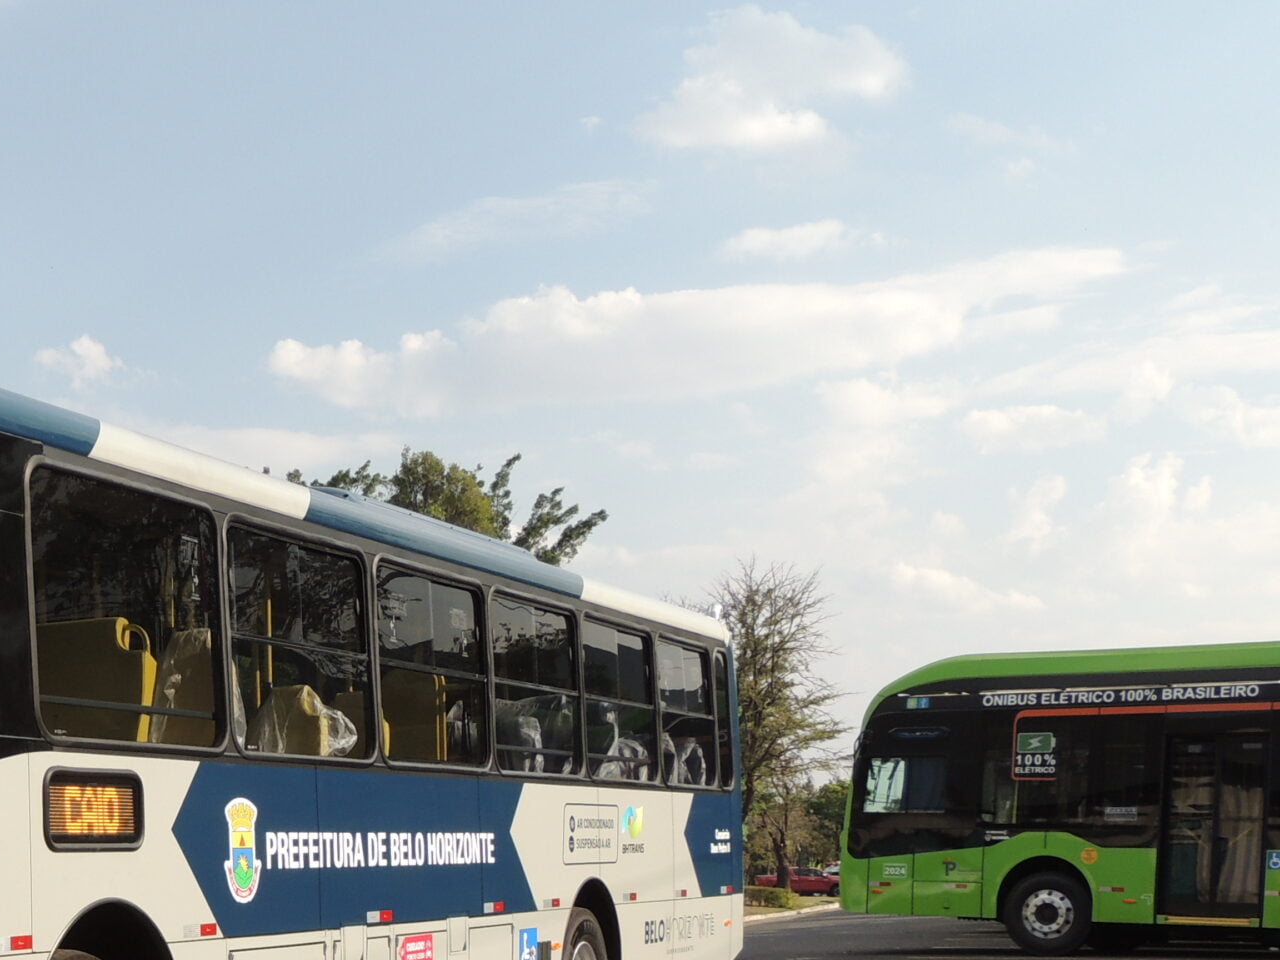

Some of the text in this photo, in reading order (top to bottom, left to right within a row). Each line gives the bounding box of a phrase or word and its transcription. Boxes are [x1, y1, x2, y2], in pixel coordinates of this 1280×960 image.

[1119, 688, 1157, 702] 100%
[1162, 684, 1259, 700] BRASILEIRO
[1016, 754, 1056, 765] 100%
[64, 785, 119, 834] CAIO
[266, 831, 496, 869] PREFEITURA DE BELO HORIZONTE
[644, 919, 665, 944] BELO
